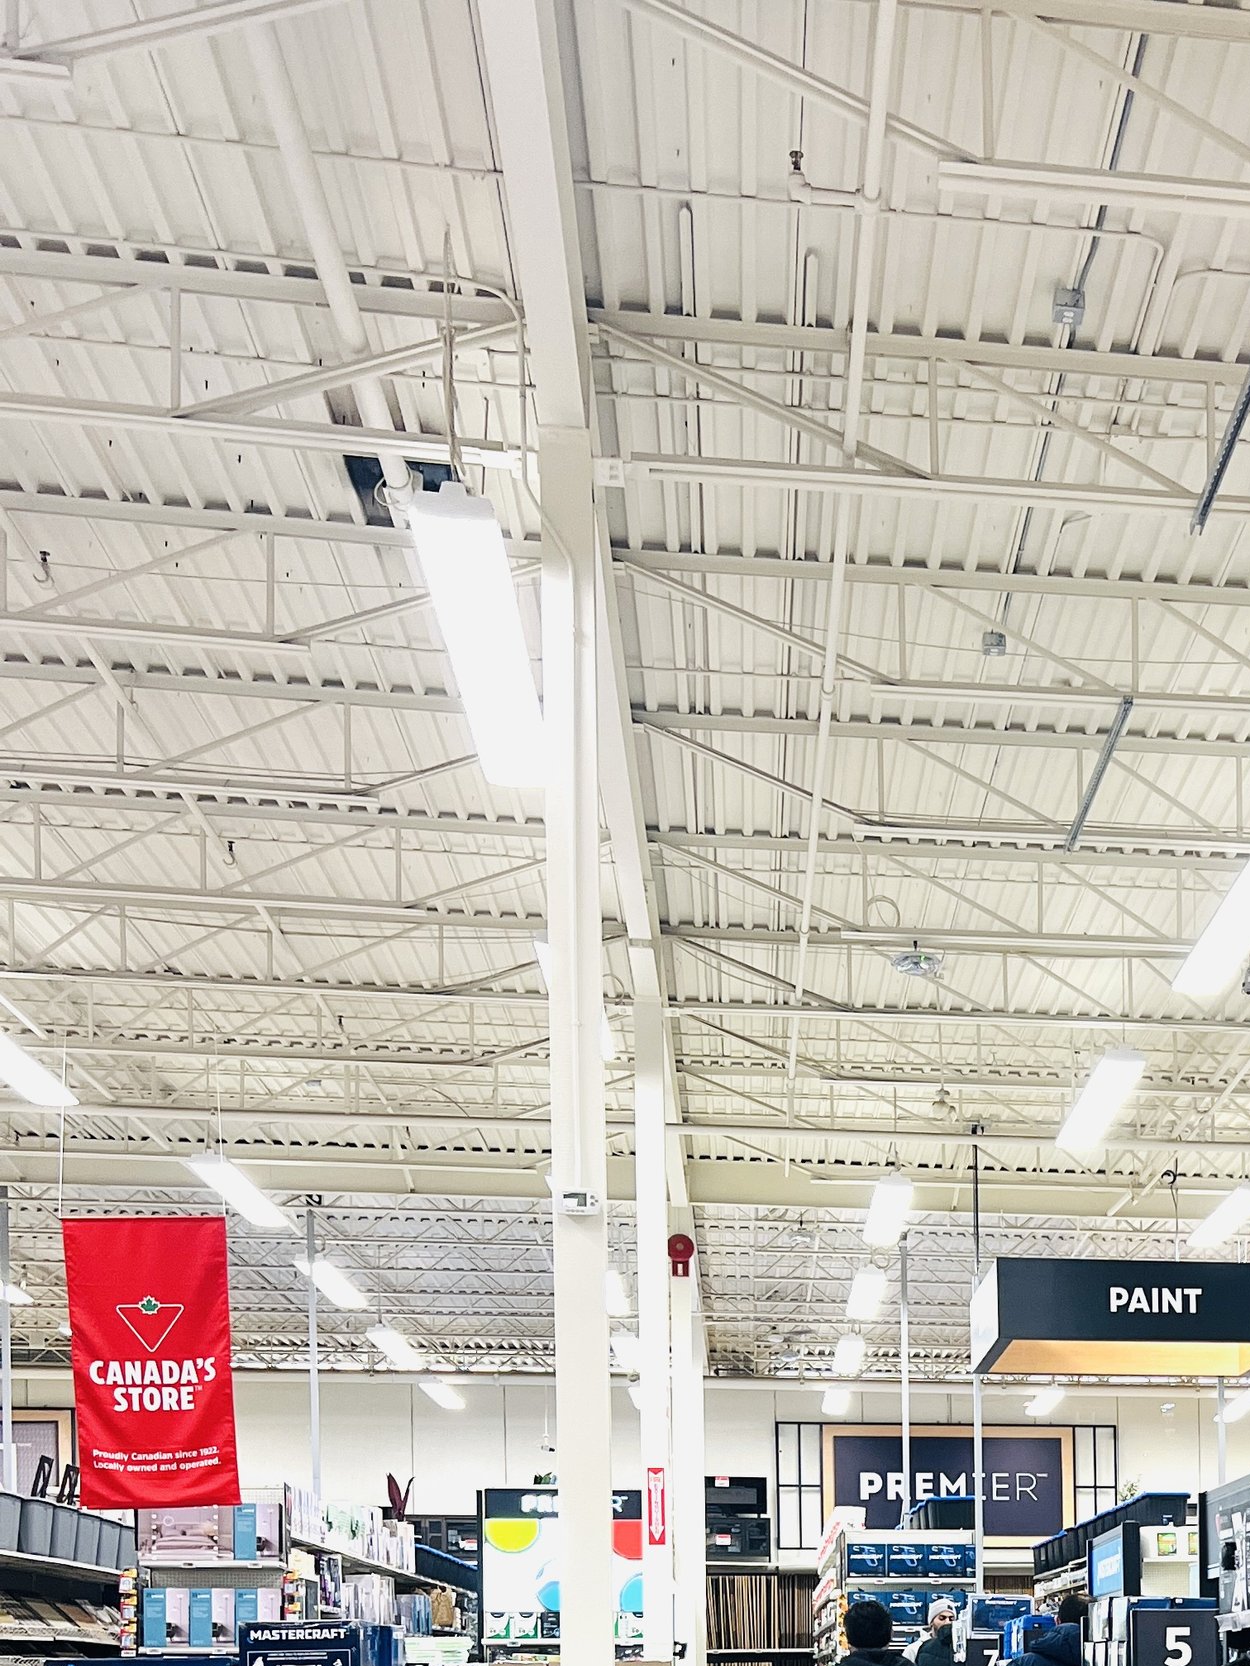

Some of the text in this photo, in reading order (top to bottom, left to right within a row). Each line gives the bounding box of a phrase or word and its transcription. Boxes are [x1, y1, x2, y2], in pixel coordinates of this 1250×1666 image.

[1108, 1286, 1204, 1314] PAINT
[89, 1356, 217, 1386] CANADA'S
[93, 1448, 129, 1462] Proudly
[131, 1449, 173, 1461] Canadian
[175, 1448, 198, 1459] since
[93, 1457, 222, 1473] Locally owned and operated.
[250, 1628, 348, 1641] MASTERCRAFT
